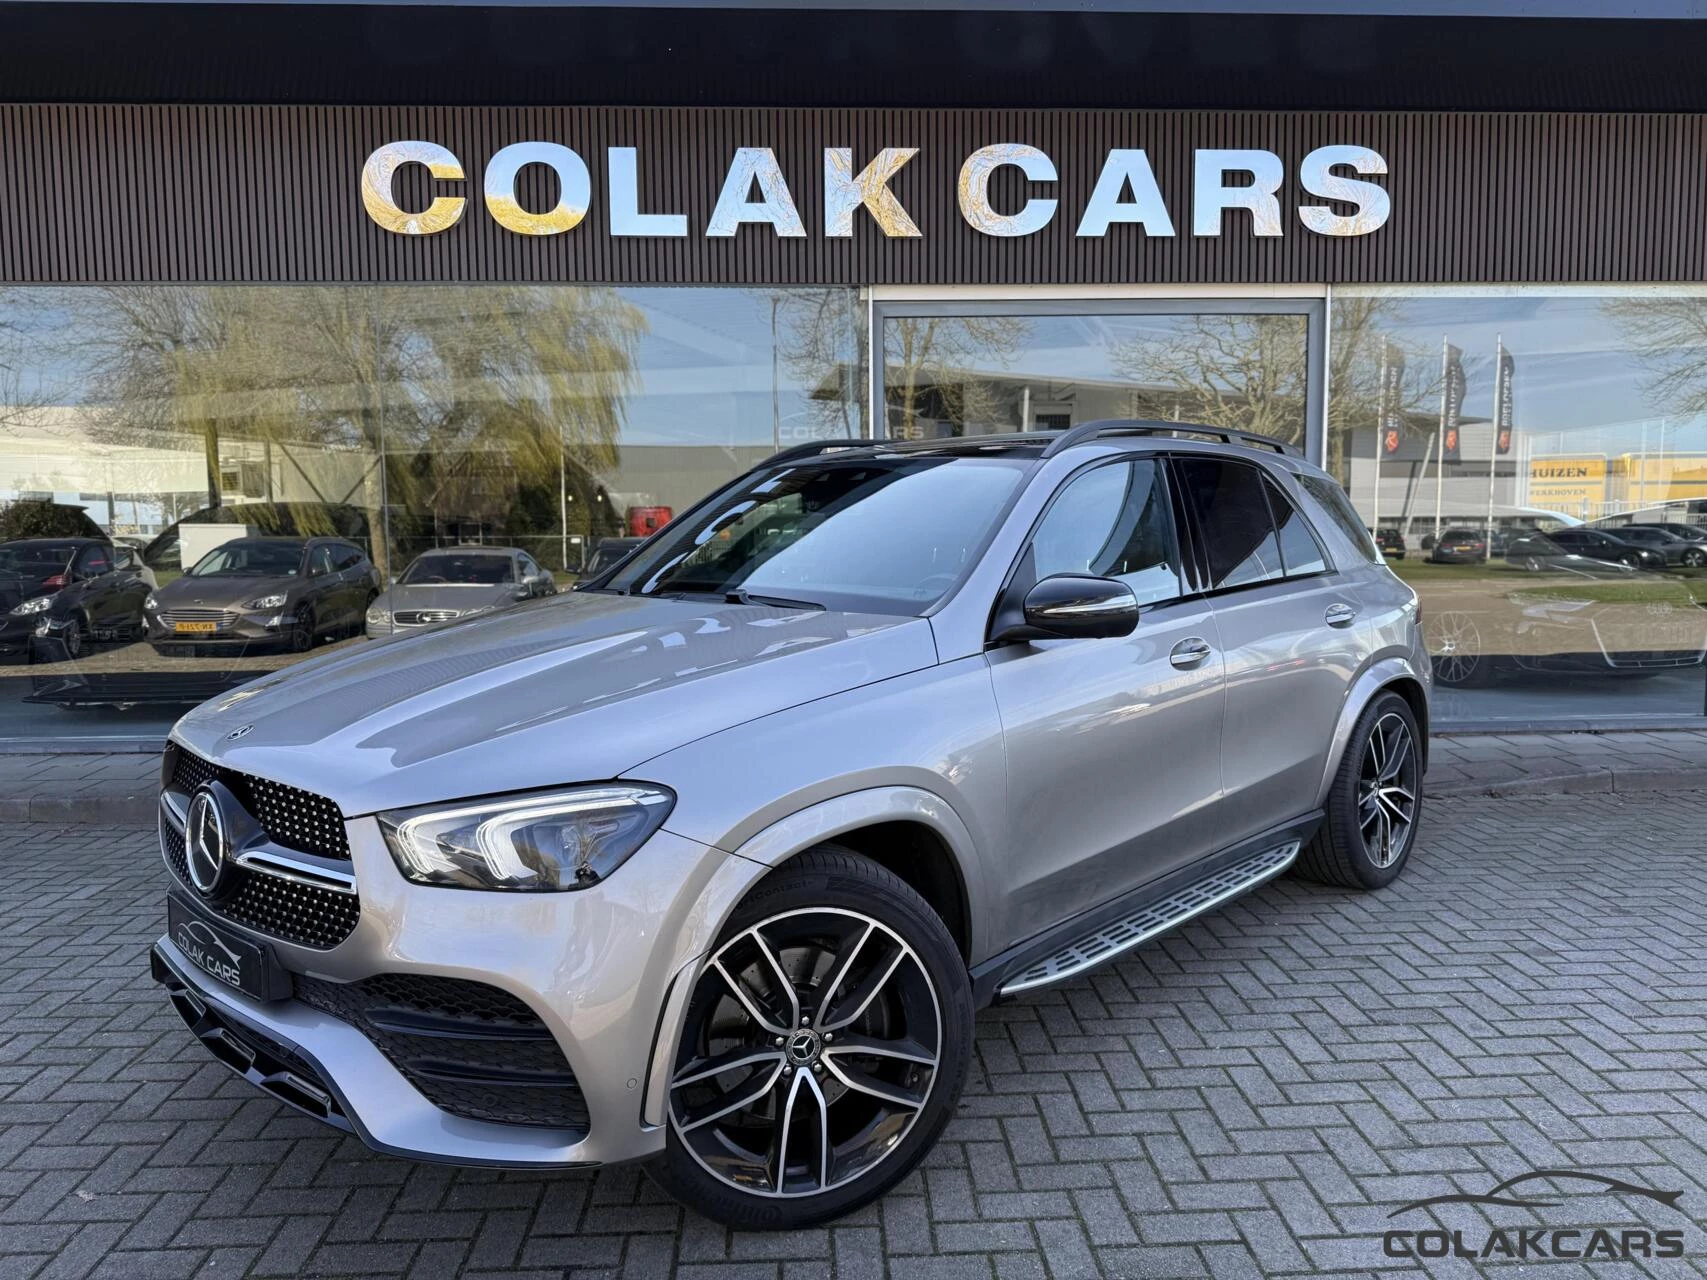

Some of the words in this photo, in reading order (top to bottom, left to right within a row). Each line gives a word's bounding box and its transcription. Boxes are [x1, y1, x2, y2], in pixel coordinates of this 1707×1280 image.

[361, 140, 922, 237] COLAK
[958, 143, 1391, 237] CARS
[178, 932, 205, 965] COLAK
[206, 955, 240, 986] CARS
